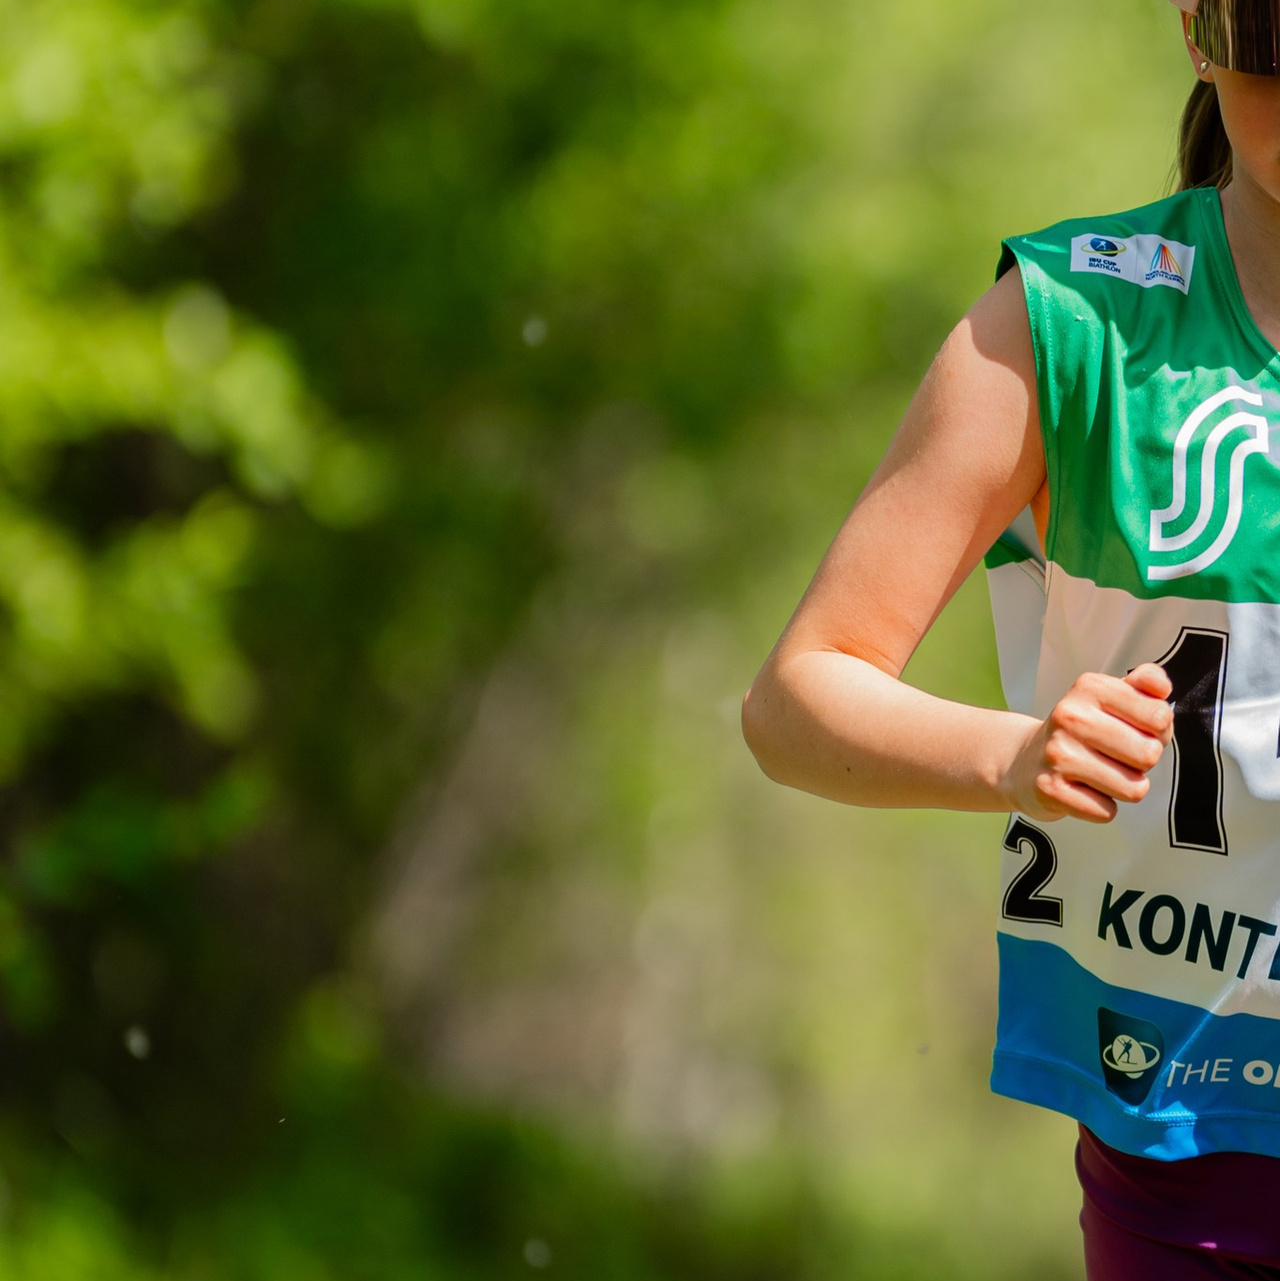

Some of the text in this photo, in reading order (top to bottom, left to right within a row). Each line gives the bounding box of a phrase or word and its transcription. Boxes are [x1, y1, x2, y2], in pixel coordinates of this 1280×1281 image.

[1088, 262, 1121, 273] BIATHLON
[1103, 259, 1117, 267] CUP
[1165, 1058, 1233, 1088] THE
